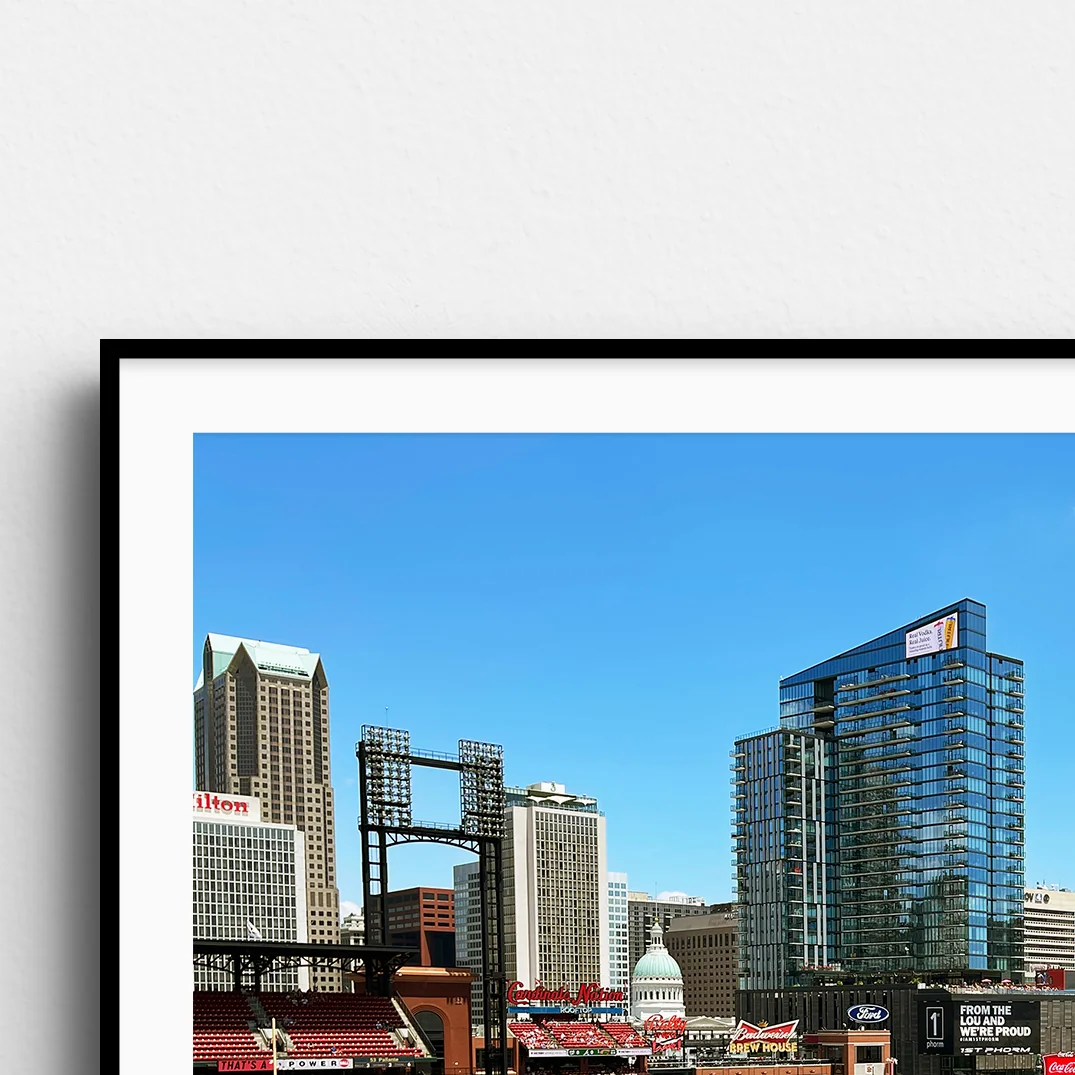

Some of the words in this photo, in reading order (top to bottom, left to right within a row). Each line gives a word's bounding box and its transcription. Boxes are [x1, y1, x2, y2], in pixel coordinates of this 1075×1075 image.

[193, 793, 248, 813] ilton
[507, 981, 571, 1005] Cardinals
[571, 983, 624, 1005] Nation
[855, 1006, 882, 1020] Ford
[960, 1005, 990, 1015] FROM
[992, 1005, 1012, 1015] THE
[960, 1016, 981, 1026] LOU
[982, 1016, 1005, 1026] AND
[729, 1027, 798, 1041] Budweiser
[959, 1026, 993, 1037] WE'RE
[995, 1026, 1032, 1037] PROUD
[729, 1042, 760, 1053] BREW
[762, 1042, 798, 1053] HOUSE
[926, 1040, 945, 1049] phorm
[984, 1046, 1031, 1054] PHORM
[220, 1060, 257, 1070] THAT'S
[261, 1060, 268, 1069] A
[288, 1060, 338, 1068] POWER
